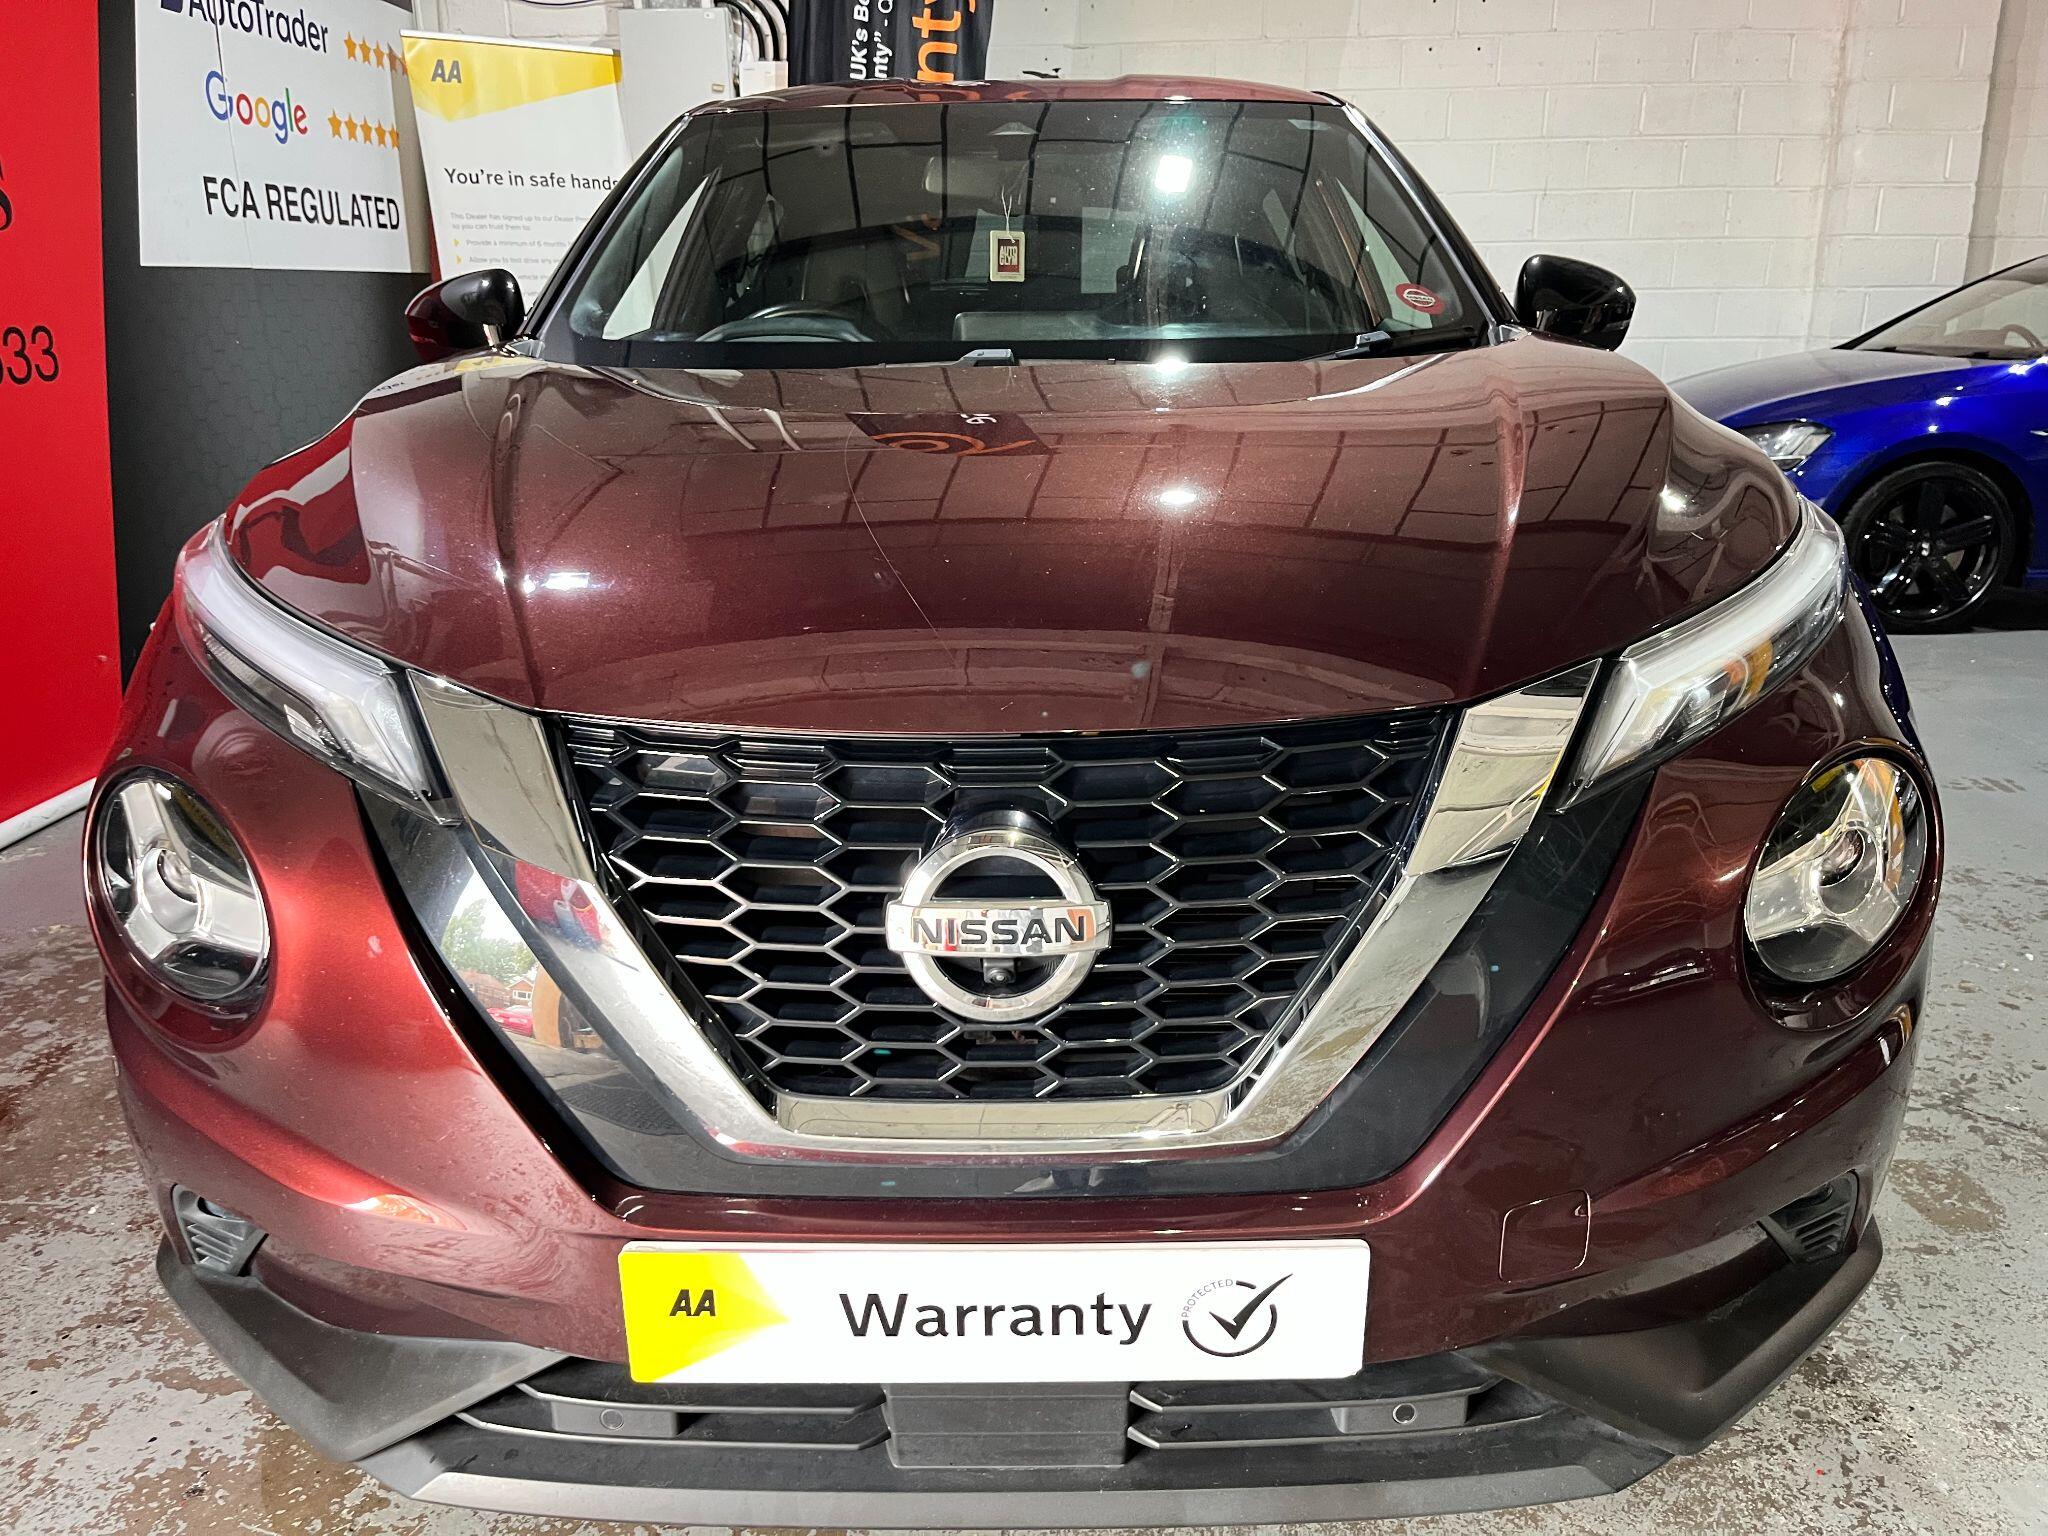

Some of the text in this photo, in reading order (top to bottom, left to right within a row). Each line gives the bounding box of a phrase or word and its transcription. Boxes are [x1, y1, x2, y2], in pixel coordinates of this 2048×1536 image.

[431, 59, 462, 84] AA
[850, 28, 868, 80] UK's
[205, 70, 308, 144] Google
[203, 176, 400, 230] FCA REGULATED
[508, 170, 525, 187] in
[530, 172, 566, 189] safe
[912, 914, 1085, 945] NISSAN
[669, 1278, 1234, 1346] AA Warranty PROTECTED
